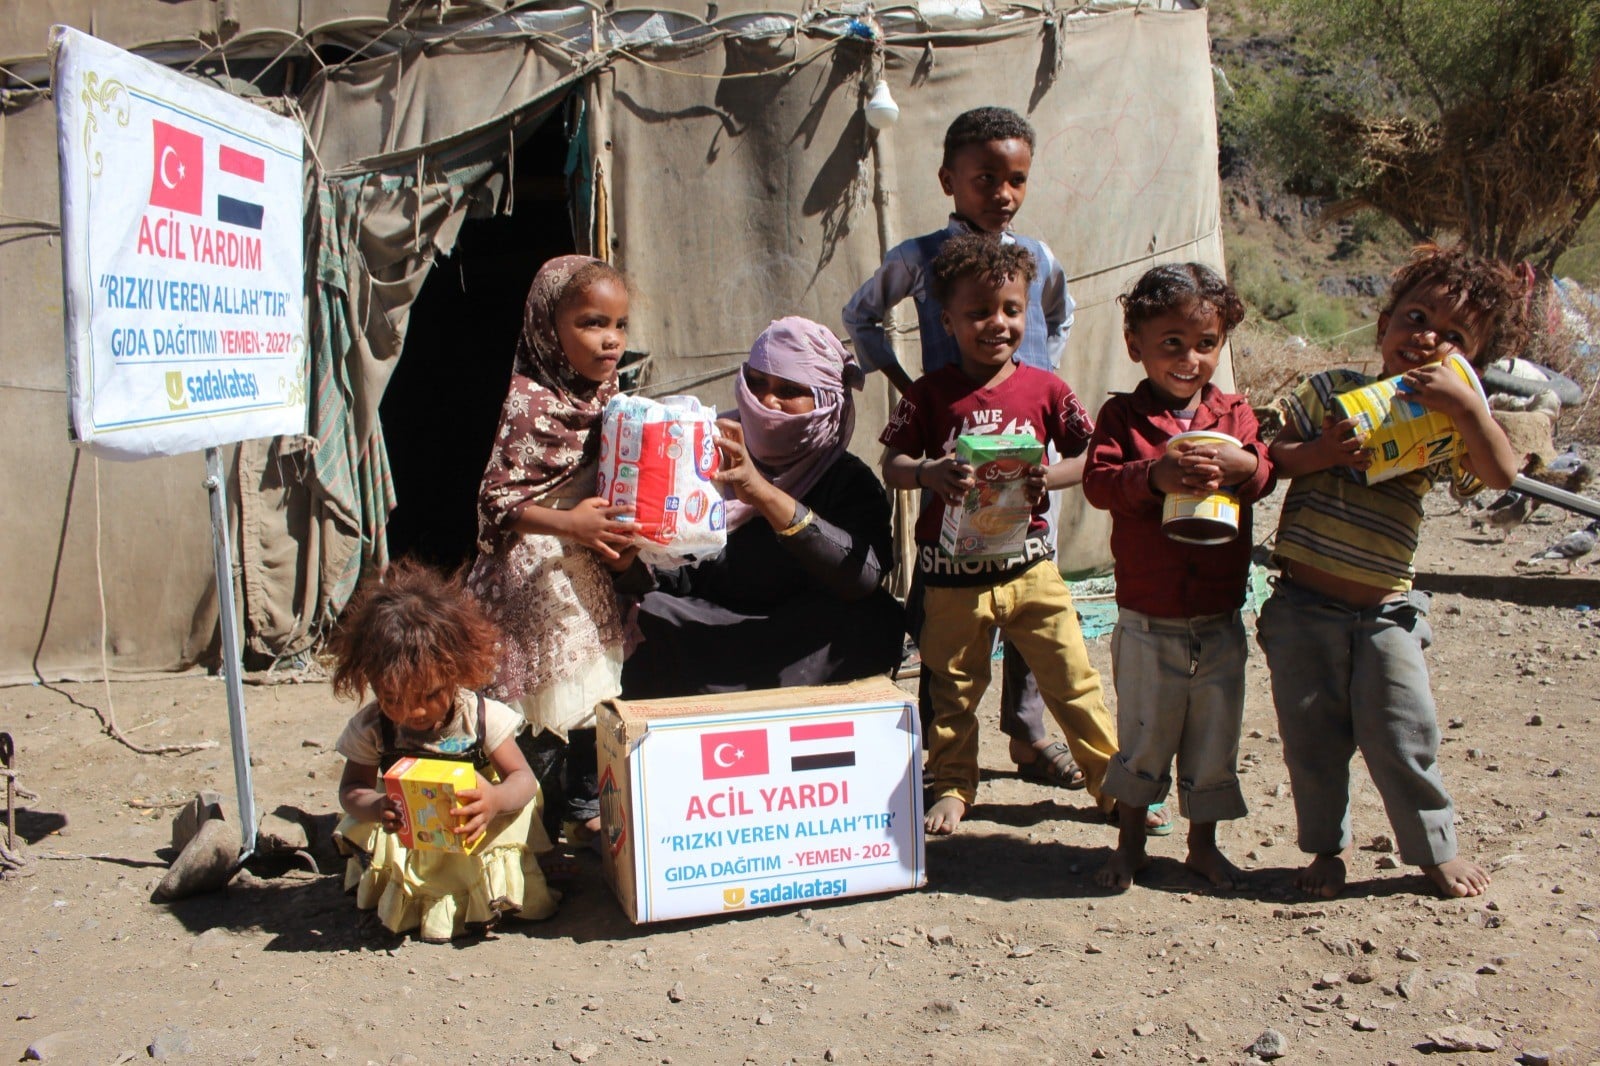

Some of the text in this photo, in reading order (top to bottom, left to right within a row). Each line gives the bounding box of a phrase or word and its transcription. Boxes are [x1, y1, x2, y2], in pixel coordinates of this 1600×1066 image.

[137, 210, 261, 271] ACİL YARDIM
[157, 280, 210, 312] VEREN
[111, 328, 150, 357] GIDA
[153, 324, 217, 356] DAĞITIMI
[187, 368, 259, 403] sadakataşı
[972, 409, 1003, 425] WE
[686, 780, 848, 821] ACİL YARDI
[727, 823, 790, 845] VEREN
[664, 864, 707, 882] GIDA
[711, 856, 781, 877] DAĞITIM
[750, 878, 847, 904] sadakataşı
